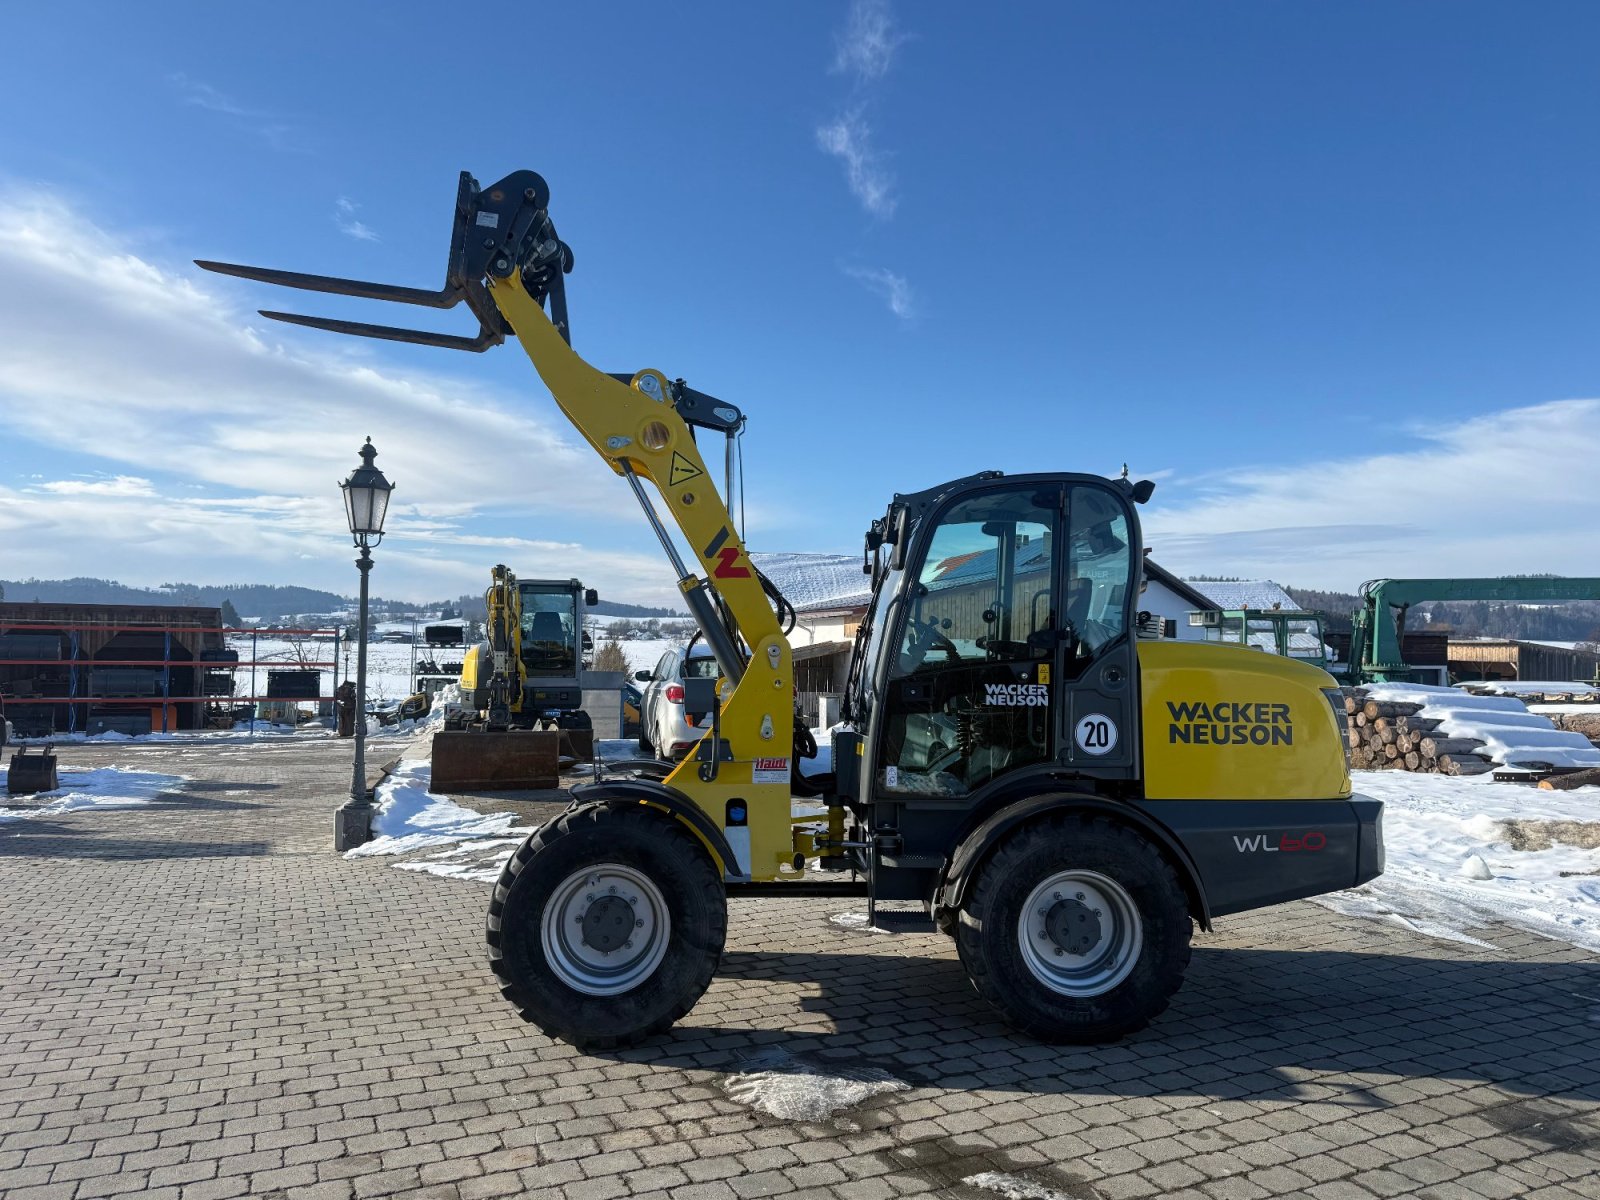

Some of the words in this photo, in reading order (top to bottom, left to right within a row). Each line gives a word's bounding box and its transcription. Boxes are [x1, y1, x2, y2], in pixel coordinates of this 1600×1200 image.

[984, 683, 1048, 696] WACKER
[985, 694, 1049, 707] NEUSON
[1166, 701, 1292, 724] WACKER
[1084, 721, 1109, 748] 20
[1169, 723, 1293, 746] NEUSON
[1232, 832, 1328, 853] WL60
